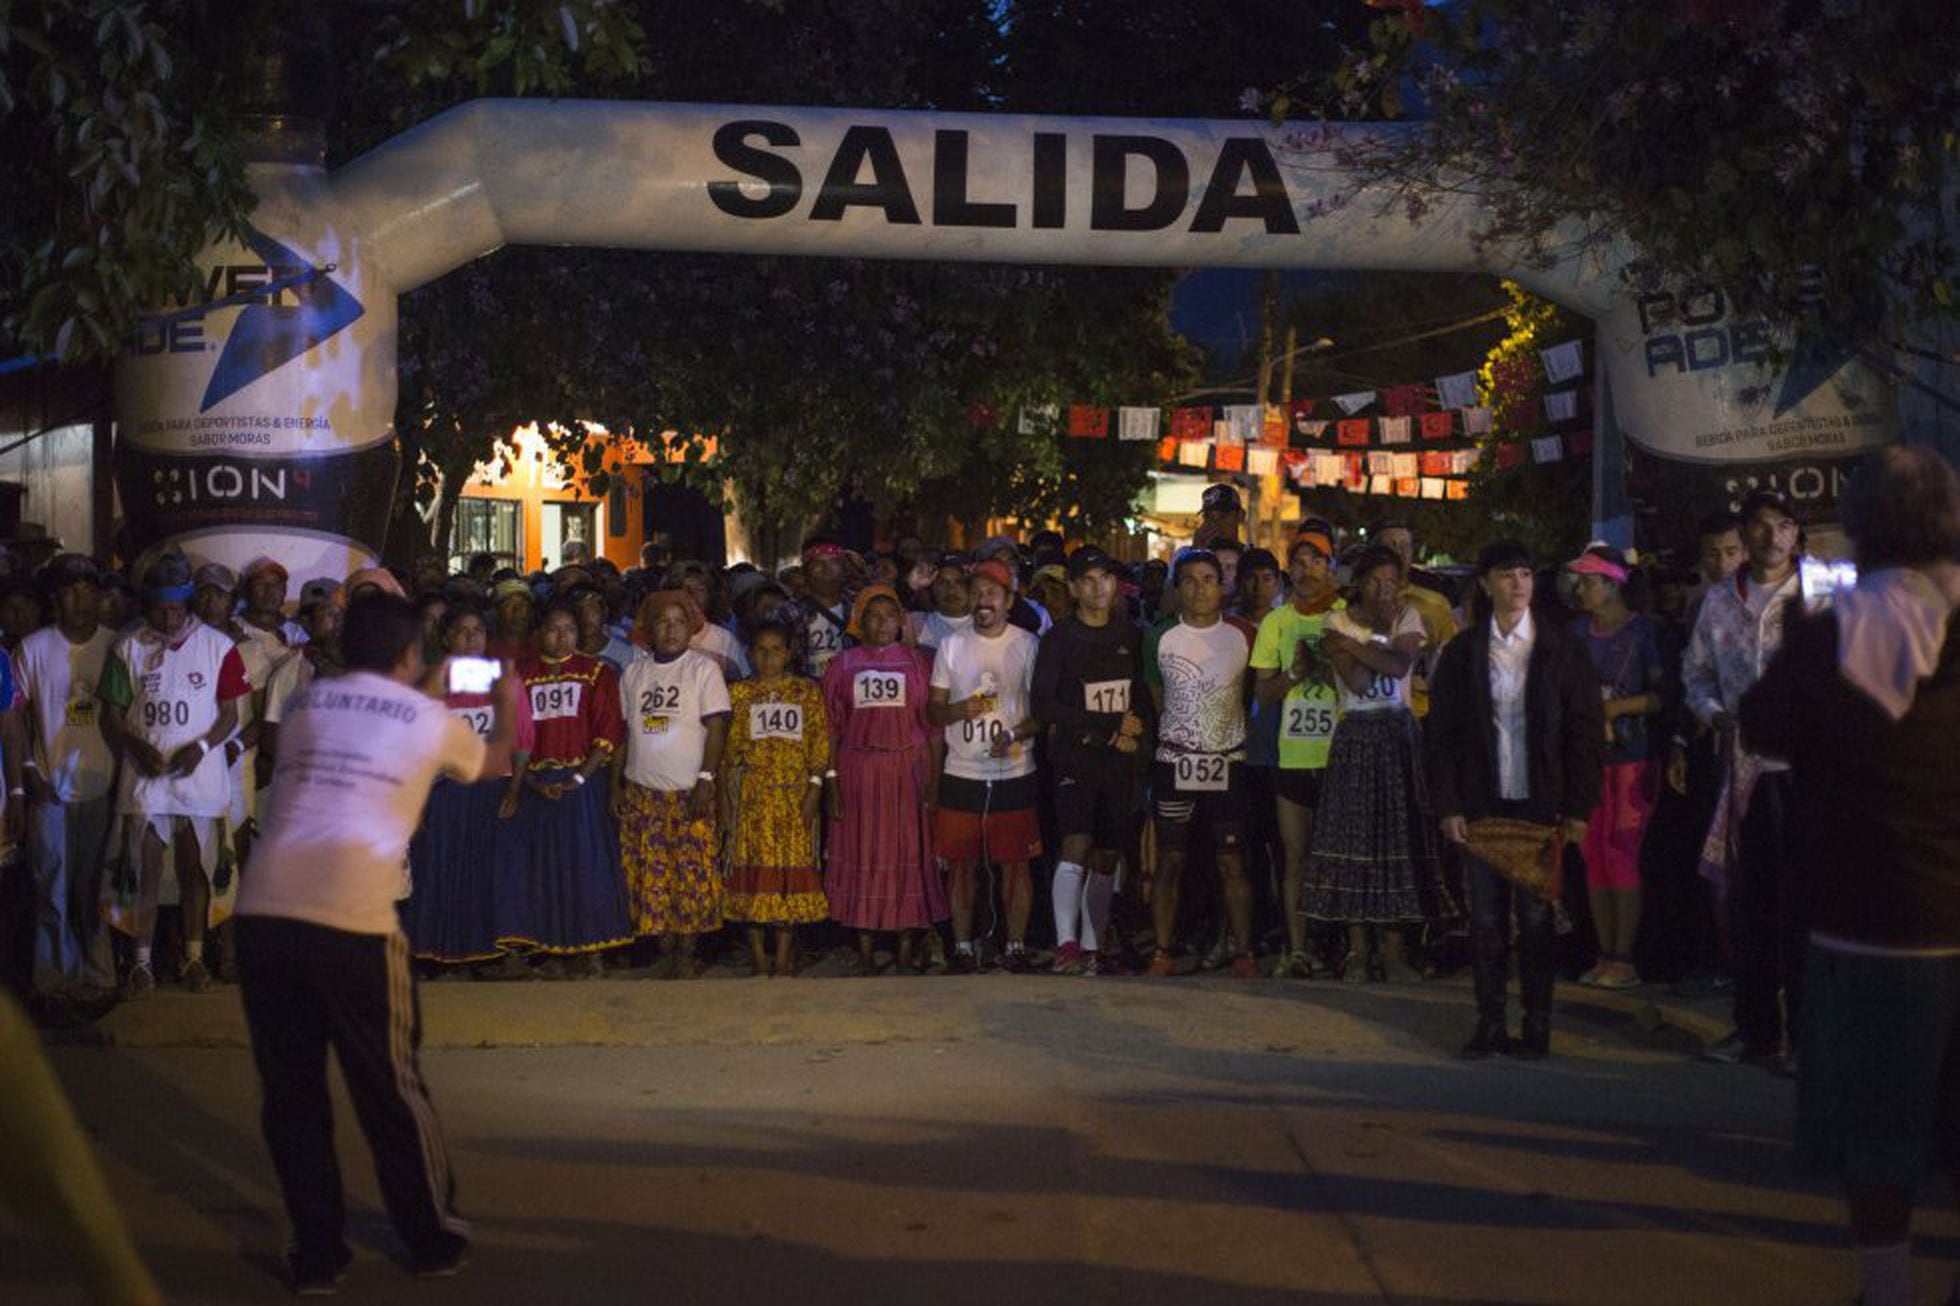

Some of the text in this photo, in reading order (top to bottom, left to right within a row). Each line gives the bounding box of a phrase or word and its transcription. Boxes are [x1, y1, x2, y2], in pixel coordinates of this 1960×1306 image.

[707, 120, 1301, 235] SALIDA
[228, 433, 271, 446] MORAS
[535, 687, 574, 712] 091
[640, 686, 680, 713] 262
[860, 677, 899, 699] 139
[1093, 688, 1126, 713] 171
[145, 700, 189, 727] 980
[757, 709, 799, 731] 140
[1289, 708, 1332, 733] 255
[963, 720, 1003, 743] 010
[1178, 757, 1225, 782] 052
